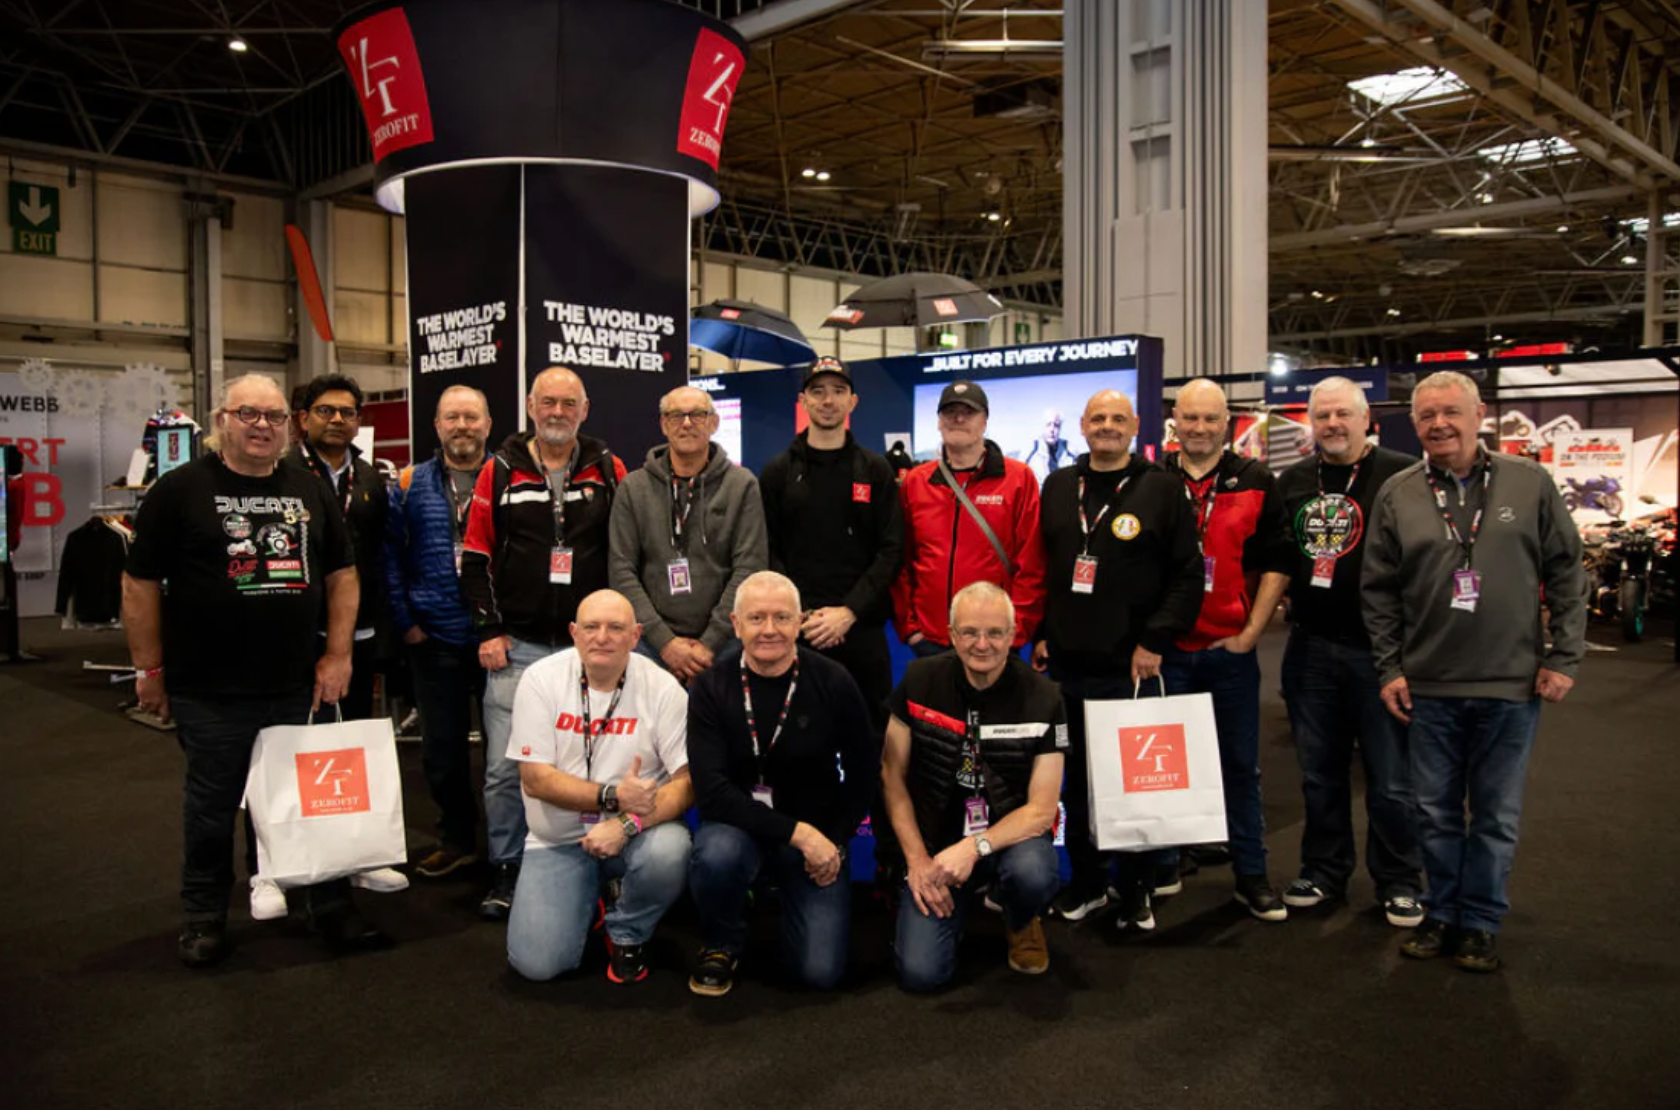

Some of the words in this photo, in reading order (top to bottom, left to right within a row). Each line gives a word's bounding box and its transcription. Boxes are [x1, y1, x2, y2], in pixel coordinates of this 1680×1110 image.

[20, 231, 51, 252] EXIT
[417, 316, 443, 336] THE
[443, 301, 506, 330] WORLD'S
[543, 300, 586, 324] THE
[588, 307, 675, 335] WORLD'S
[427, 324, 495, 352] WARMEST
[561, 323, 661, 352] WARMEST
[420, 344, 497, 373] BASELAYER
[549, 342, 665, 372] BASELAYER
[972, 352, 1003, 369] FOR
[1004, 346, 1058, 367] EVERY
[1058, 339, 1138, 361] JOURNEY
[0, 396, 60, 413] WEBB
[0, 436, 66, 467] RT
[214, 495, 304, 514] DUCATI
[555, 712, 639, 736] DUCATI
